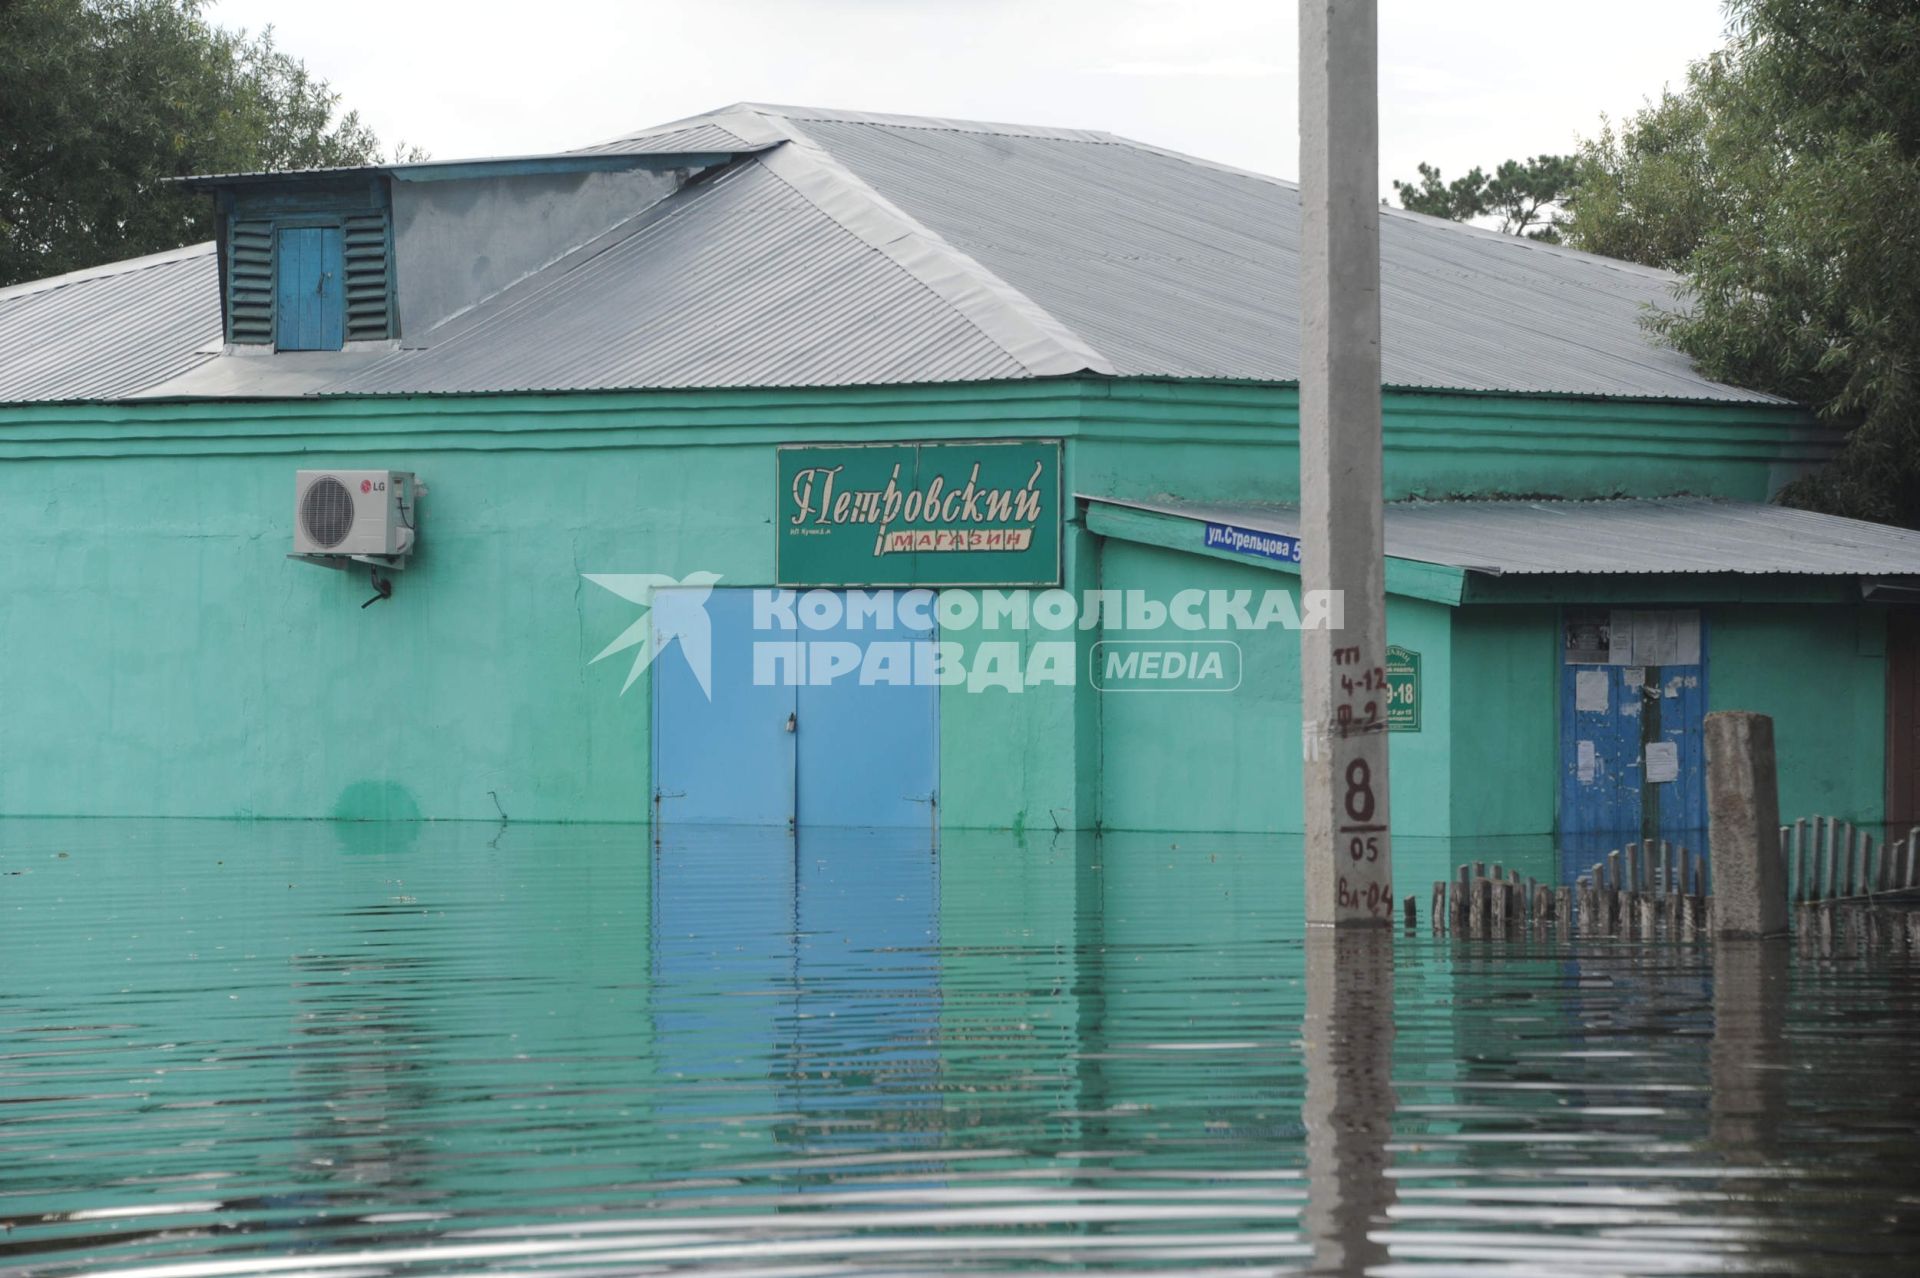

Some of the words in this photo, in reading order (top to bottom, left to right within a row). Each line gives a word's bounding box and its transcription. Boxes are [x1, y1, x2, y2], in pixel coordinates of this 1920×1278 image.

[373, 482, 385, 491] LG
[791, 460, 1043, 557] Петровский
[893, 533, 1022, 547] МАГАЗИН
[1341, 667, 1387, 697] 4-12
[1345, 757, 1375, 822] 8
[1350, 836, 1378, 862] 05
